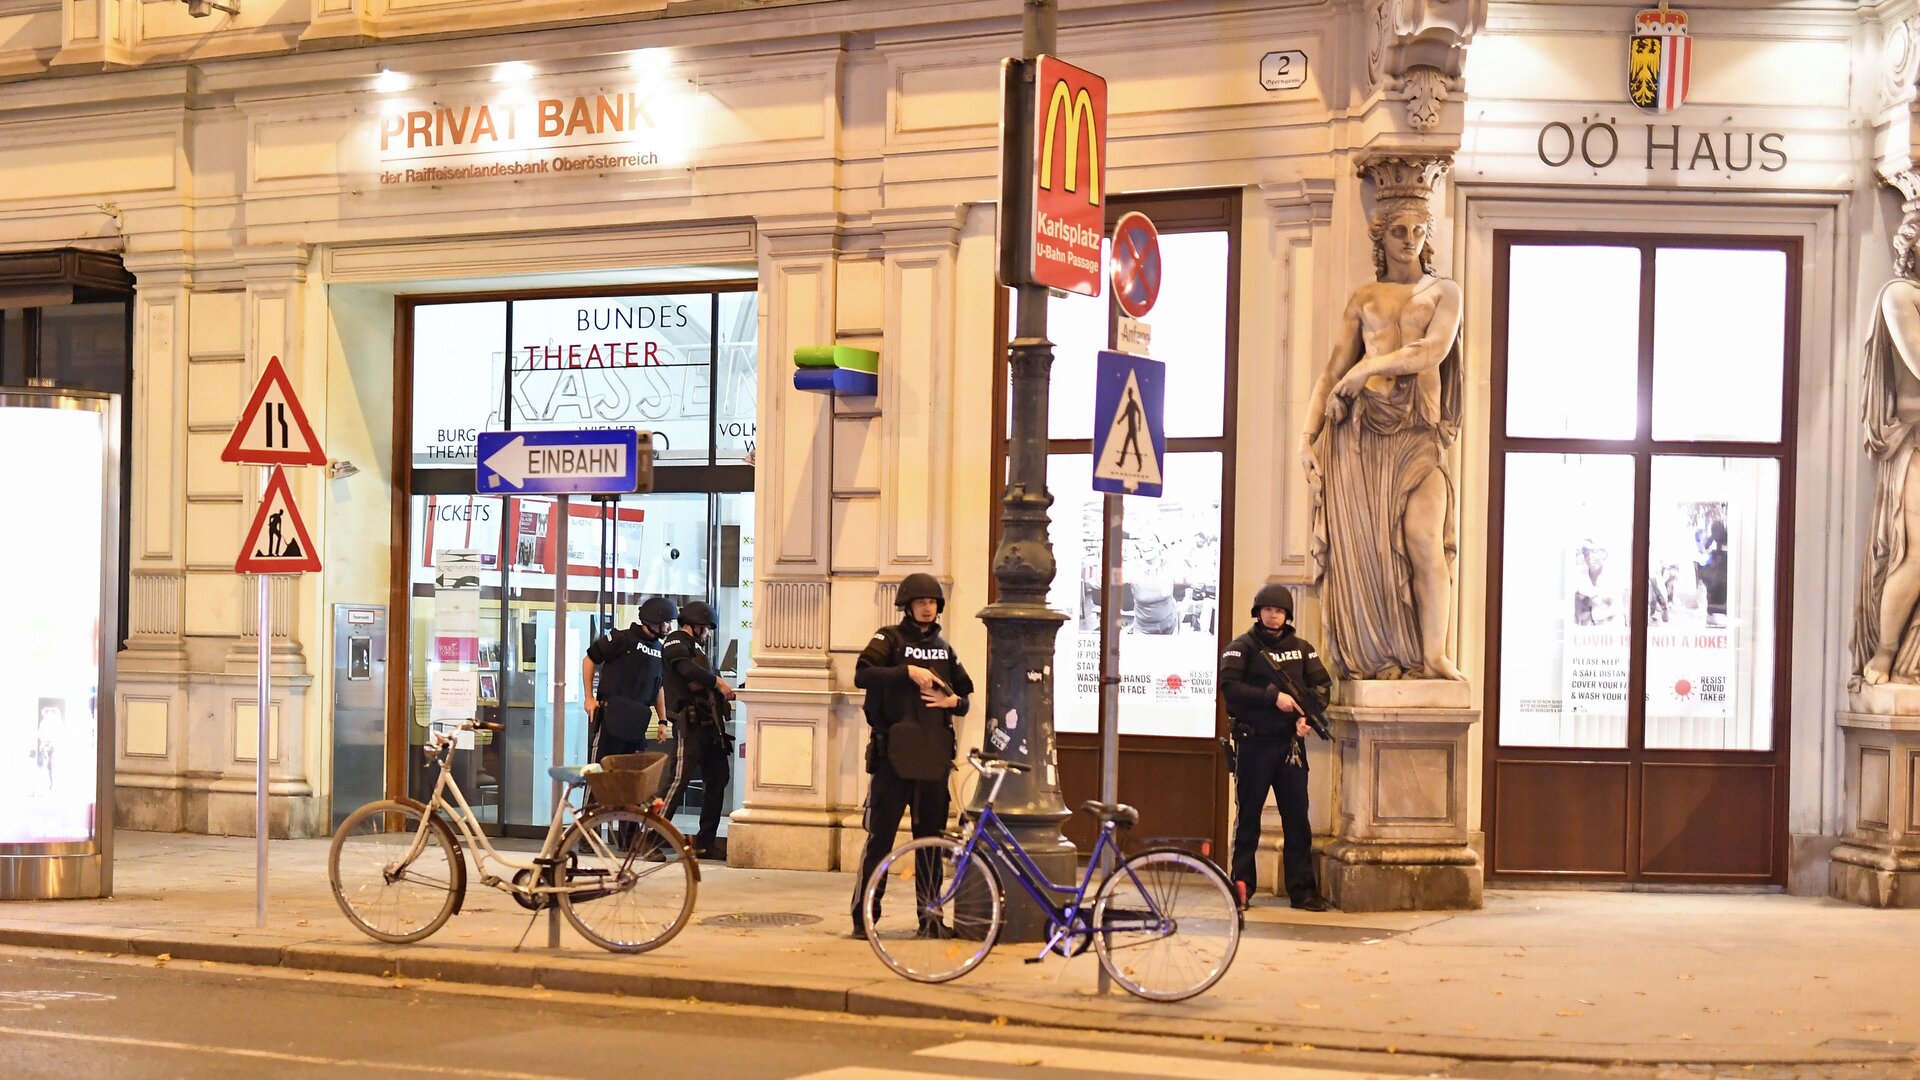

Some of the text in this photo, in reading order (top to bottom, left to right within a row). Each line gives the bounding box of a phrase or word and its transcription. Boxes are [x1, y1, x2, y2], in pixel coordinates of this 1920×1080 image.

[1277, 55, 1291, 76] 2
[380, 92, 656, 151] PRIVAT BANK
[1537, 116, 1788, 172] OÖ HAUS
[380, 151, 658, 186] der Raiffeisenlandesbank Oberösterreich
[1037, 211, 1100, 251] Karlsplatz
[1037, 242, 1099, 274] U-Bahn Passage
[577, 304, 688, 331] BUNDES
[524, 341, 662, 370] THEATER
[438, 428, 476, 442] BURG
[527, 447, 618, 476] EINBAHN
[428, 504, 490, 521] TICKETS
[1077, 639, 1097, 648] STAY
[1574, 634, 1613, 647] COVID
[1652, 635, 1676, 648] NOT
[1681, 635, 1690, 648] A
[1693, 635, 1727, 649] JOKE!
[904, 646, 949, 660] POLIZEI
[1076, 661, 1096, 671] STAY
[1572, 658, 1620, 666] PLEASE KEEP
[1076, 673, 1151, 683] WASH HANDS
[1572, 669, 1578, 677] A
[1579, 669, 1597, 677] SAFE
[1191, 678, 1212, 686] COVID
[1571, 680, 1597, 689] COVER
[1598, 681, 1618, 689] YOUR
[1700, 676, 1726, 684] RESIST
[1077, 683, 1099, 693] COVE
[1127, 685, 1147, 694] FACE
[1191, 686, 1206, 695] TAKE
[1702, 684, 1725, 692] COVID
[1570, 691, 1576, 700] &
[1578, 692, 1600, 700] WASH
[1602, 692, 1622, 701] YOUR
[1700, 693, 1726, 702] TAKE 6!
